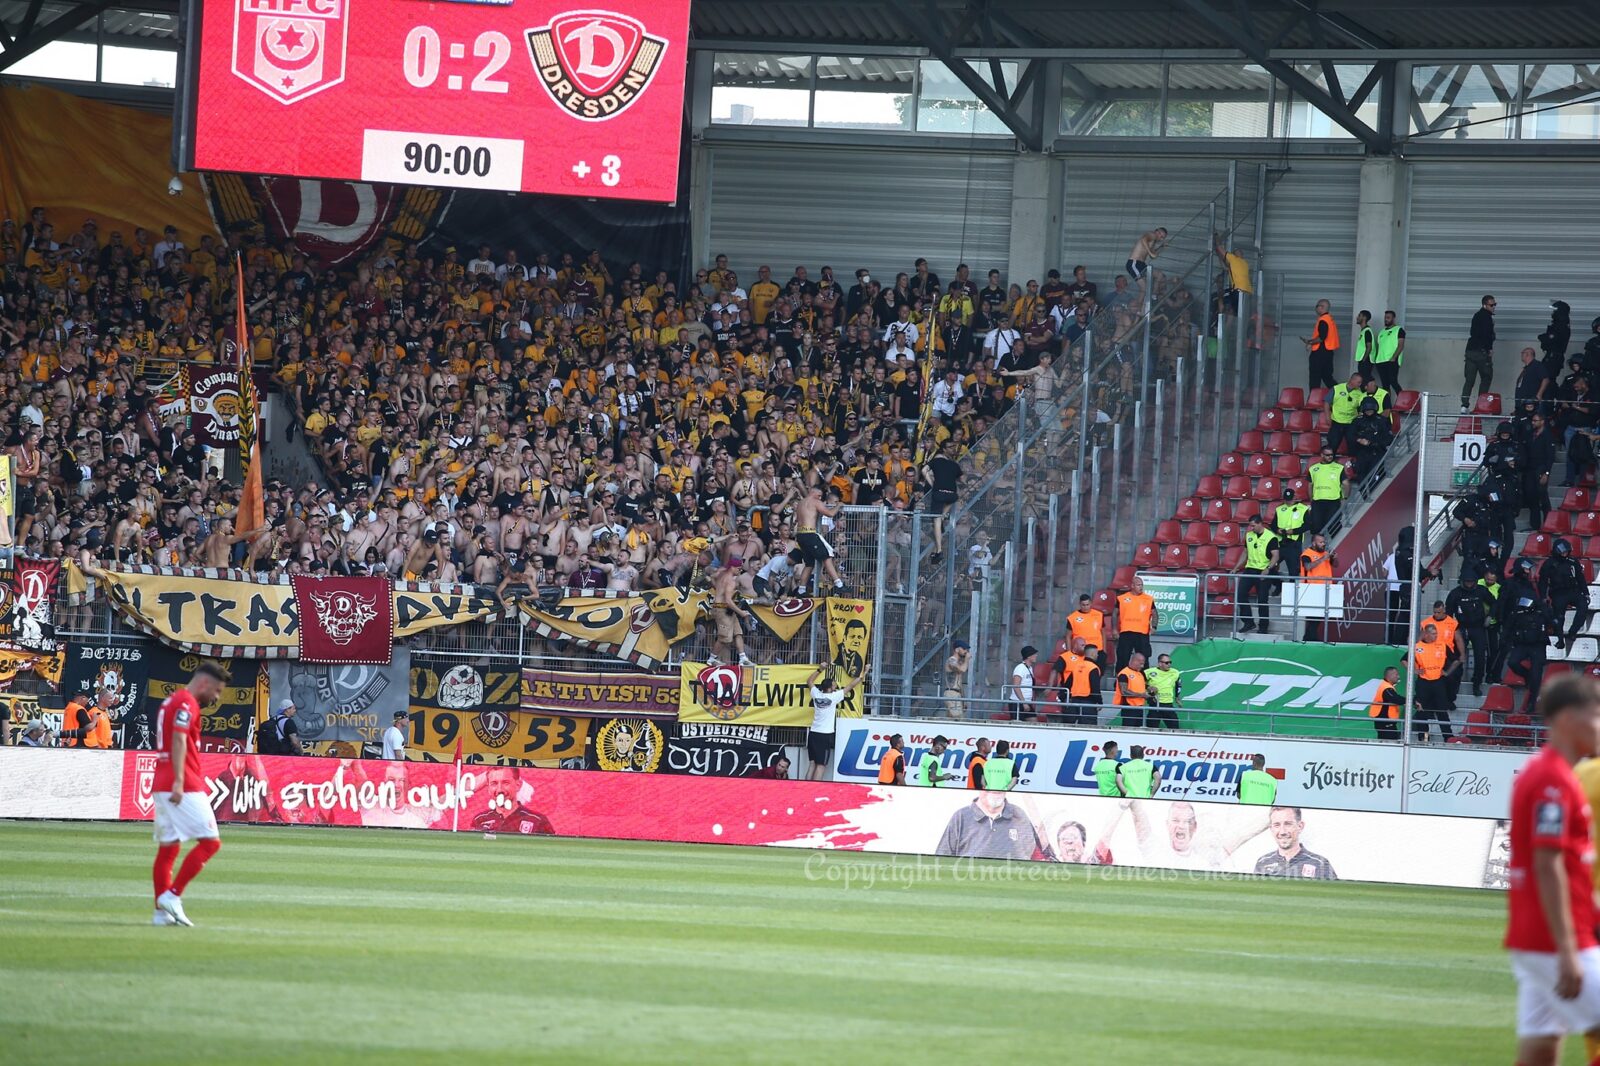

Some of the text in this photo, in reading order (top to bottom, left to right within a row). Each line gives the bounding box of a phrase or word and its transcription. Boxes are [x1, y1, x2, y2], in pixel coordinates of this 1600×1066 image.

[541, 65, 646, 117] DRESDEN
[404, 142, 491, 177] 90:00
[601, 155, 621, 186] 3
[1460, 442, 1482, 461] 10
[1179, 591, 1187, 600] &
[81, 647, 142, 661] DEVILS
[520, 679, 652, 704] AKTIVIST
[1182, 671, 1384, 711] TTM
[326, 713, 378, 727] DYNAMO
[682, 723, 770, 742] OSTDEUTSCHE
[478, 729, 511, 749] DRESDEN
[1161, 785, 1191, 794] der
[1303, 761, 1395, 793] Köstritzer
[1408, 770, 1492, 796] Edel Pils
[280, 772, 397, 811] stehen
[407, 772, 476, 811] auf
